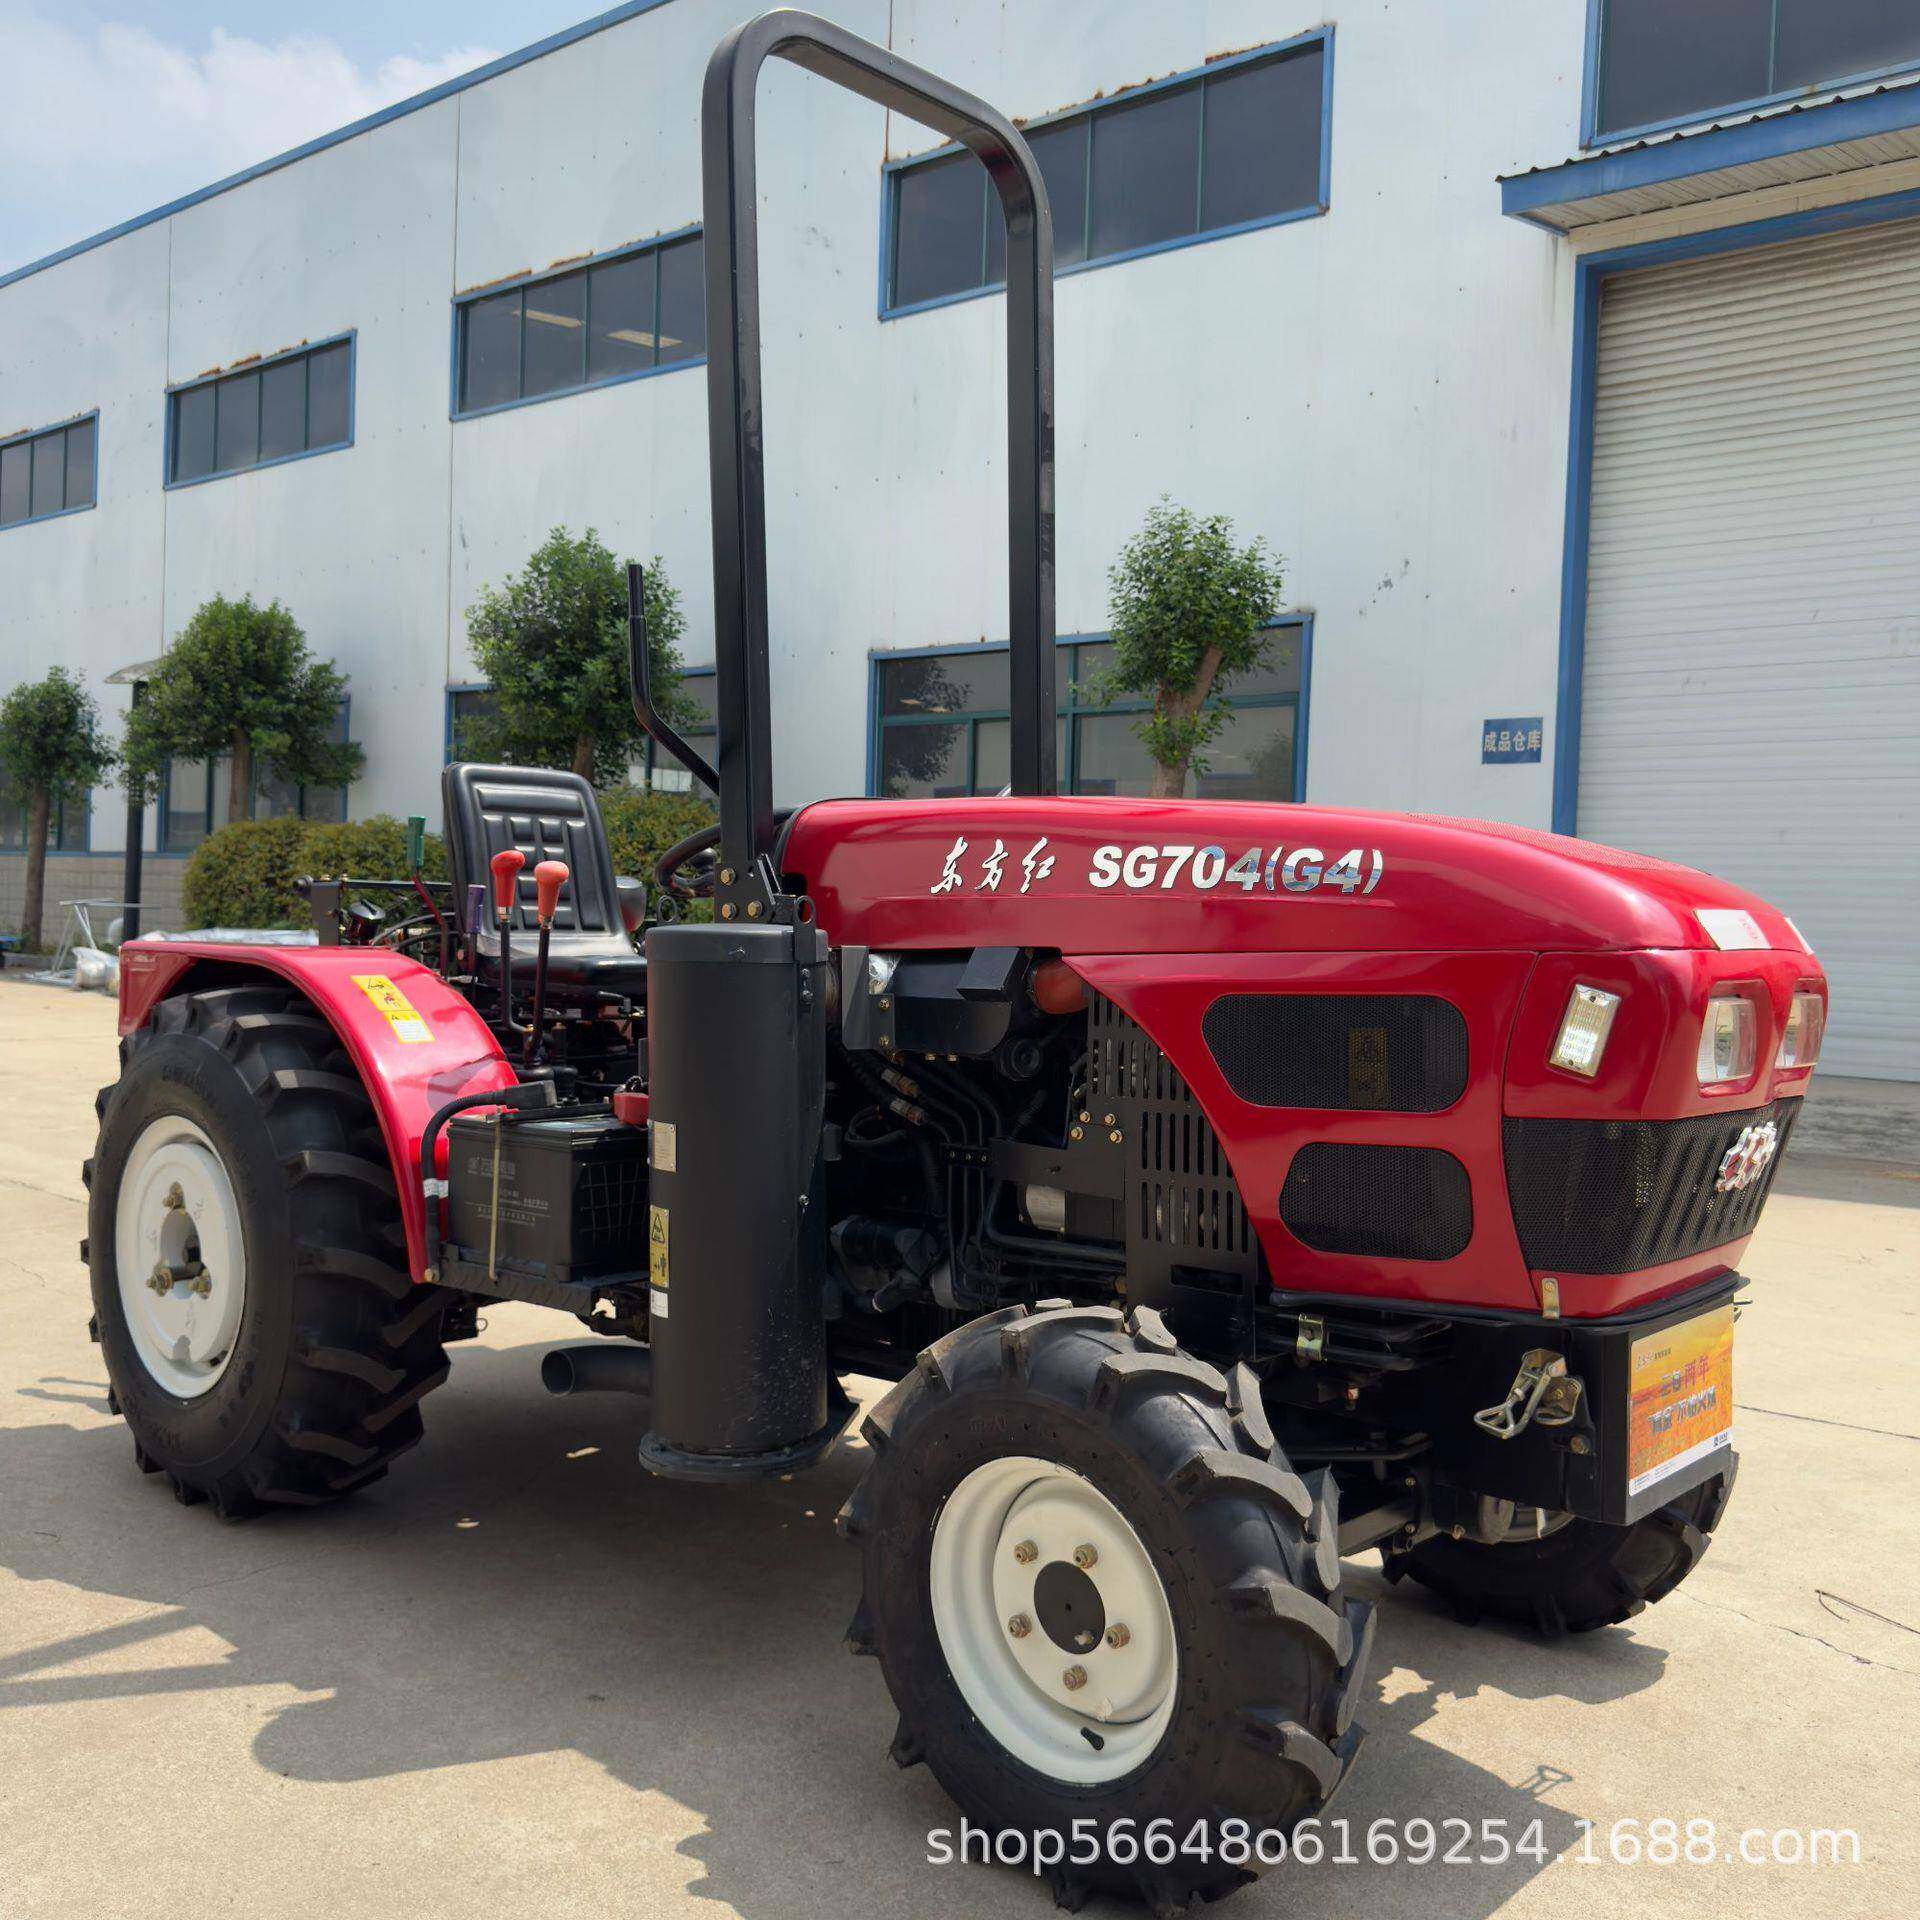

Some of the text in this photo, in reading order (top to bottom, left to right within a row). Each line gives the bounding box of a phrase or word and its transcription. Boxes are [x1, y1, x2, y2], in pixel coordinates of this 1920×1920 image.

[1484, 730, 1541, 752] 成品仓库
[930, 836, 1055, 894] 东方红
[1088, 845, 1384, 895] SG704(G4)
